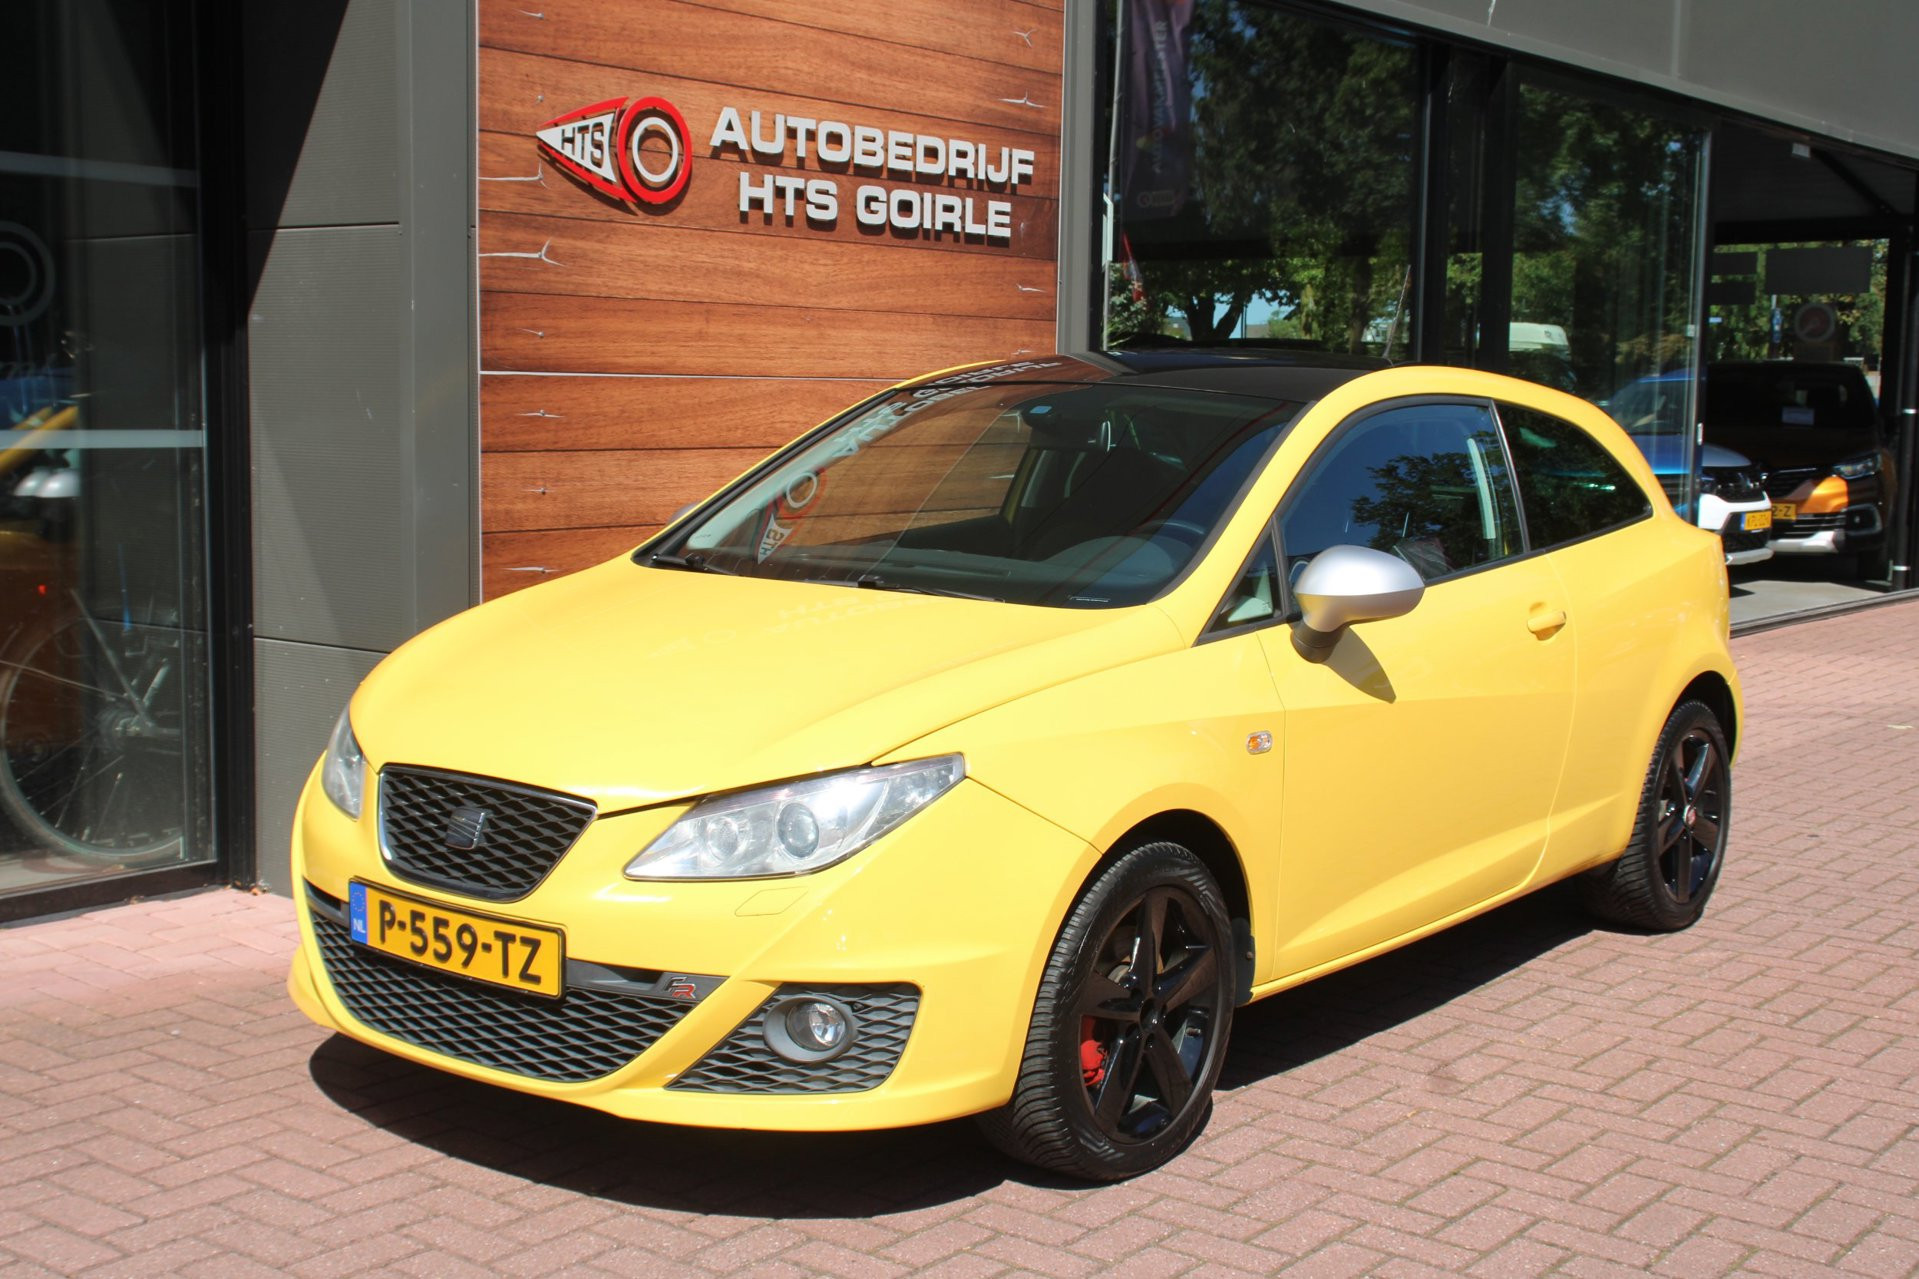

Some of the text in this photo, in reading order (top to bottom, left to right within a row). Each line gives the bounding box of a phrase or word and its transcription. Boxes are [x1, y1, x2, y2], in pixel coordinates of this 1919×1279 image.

[561, 122, 604, 169] HTS
[709, 107, 1035, 184] AUTOBEDRIJF
[739, 171, 1012, 239] HTS GOIRLE
[353, 917, 367, 934] NL
[379, 899, 542, 985] P-559-TZ
[665, 975, 697, 998] FR
